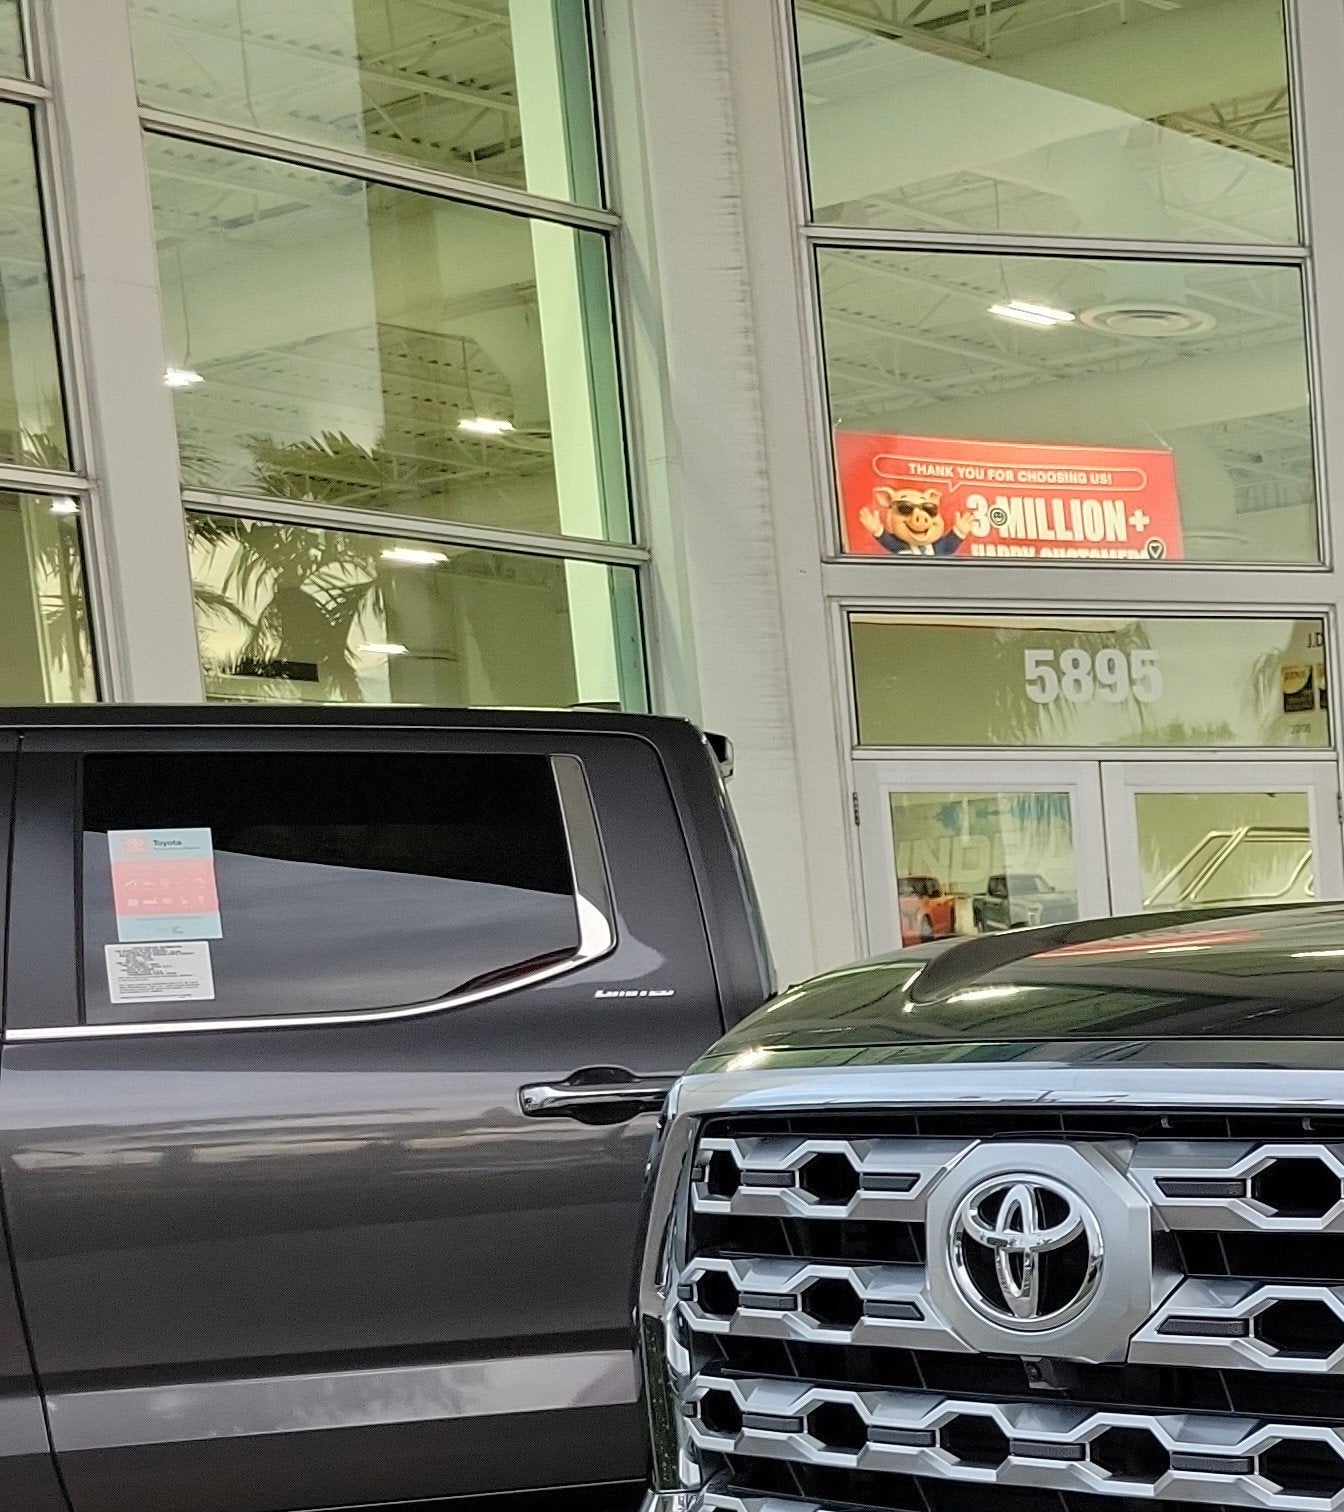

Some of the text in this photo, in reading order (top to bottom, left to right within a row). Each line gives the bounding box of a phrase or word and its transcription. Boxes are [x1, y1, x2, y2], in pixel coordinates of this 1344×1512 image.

[907, 462, 1112, 485] THANK YOU FOR CHOOSING US!
[1024, 649, 1164, 704] 5895
[153, 839, 183, 847] Toyota
